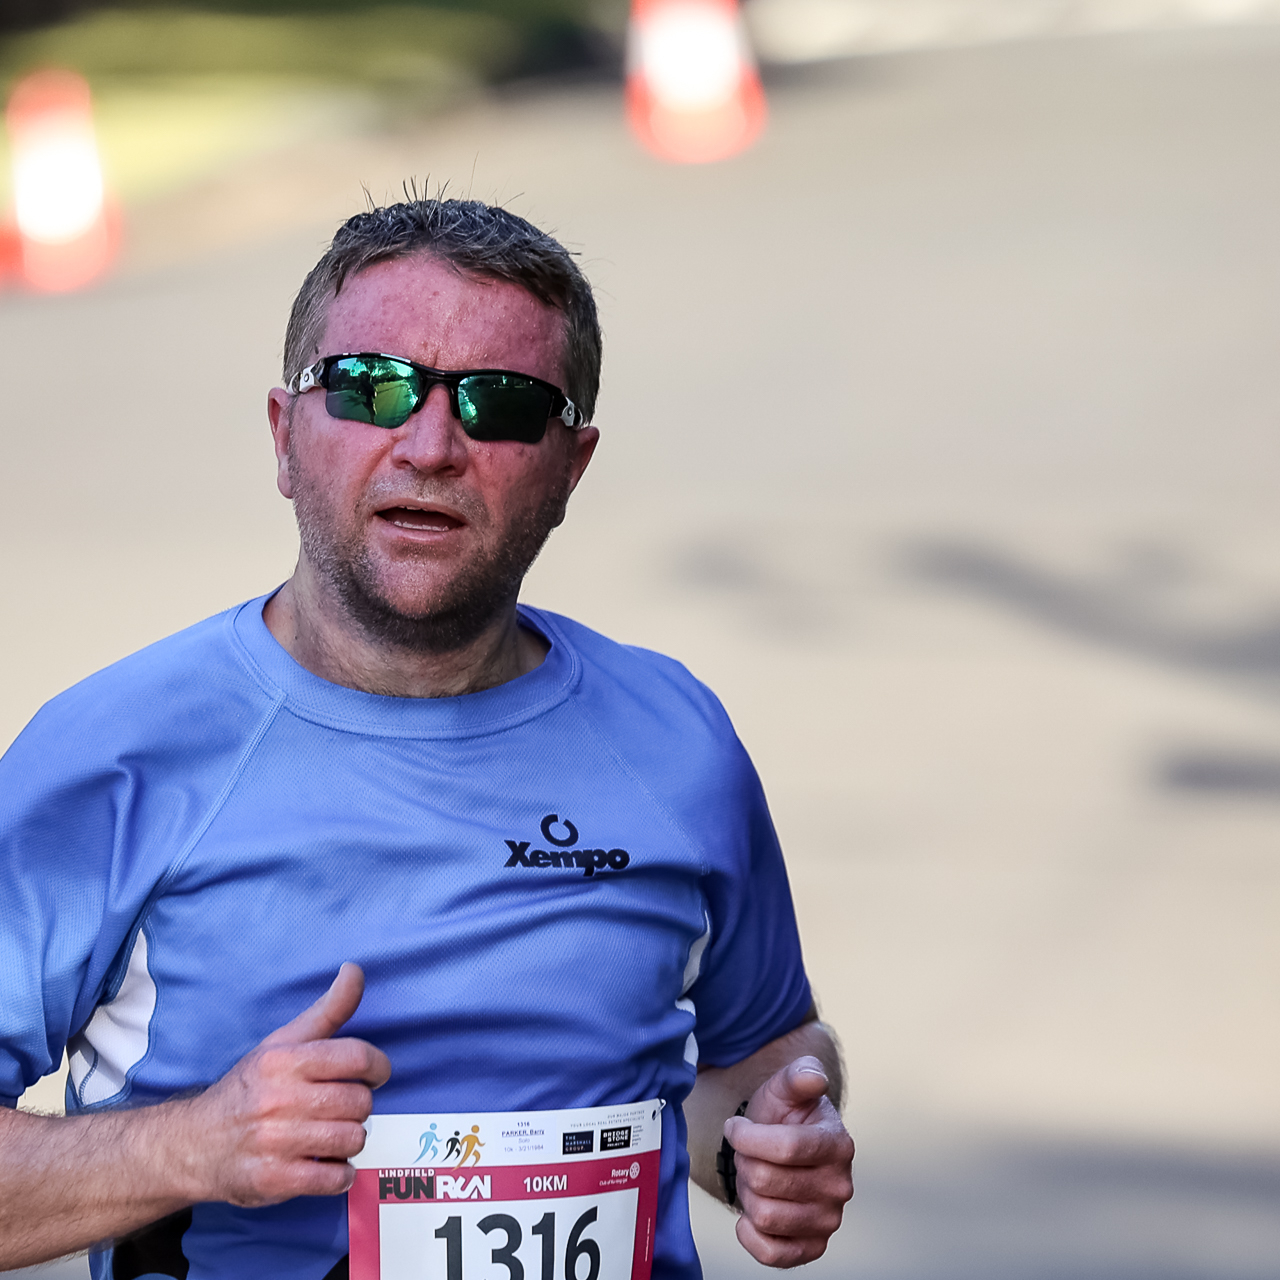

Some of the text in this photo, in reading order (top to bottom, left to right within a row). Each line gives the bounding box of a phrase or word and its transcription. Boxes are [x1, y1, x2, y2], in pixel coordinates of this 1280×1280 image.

[504, 839, 630, 877] Xempo
[378, 1168, 435, 1178] LINDFIELD
[611, 1169, 629, 1178] Rotary
[379, 1176, 434, 1200] FUN
[523, 1174, 568, 1193] 10KM
